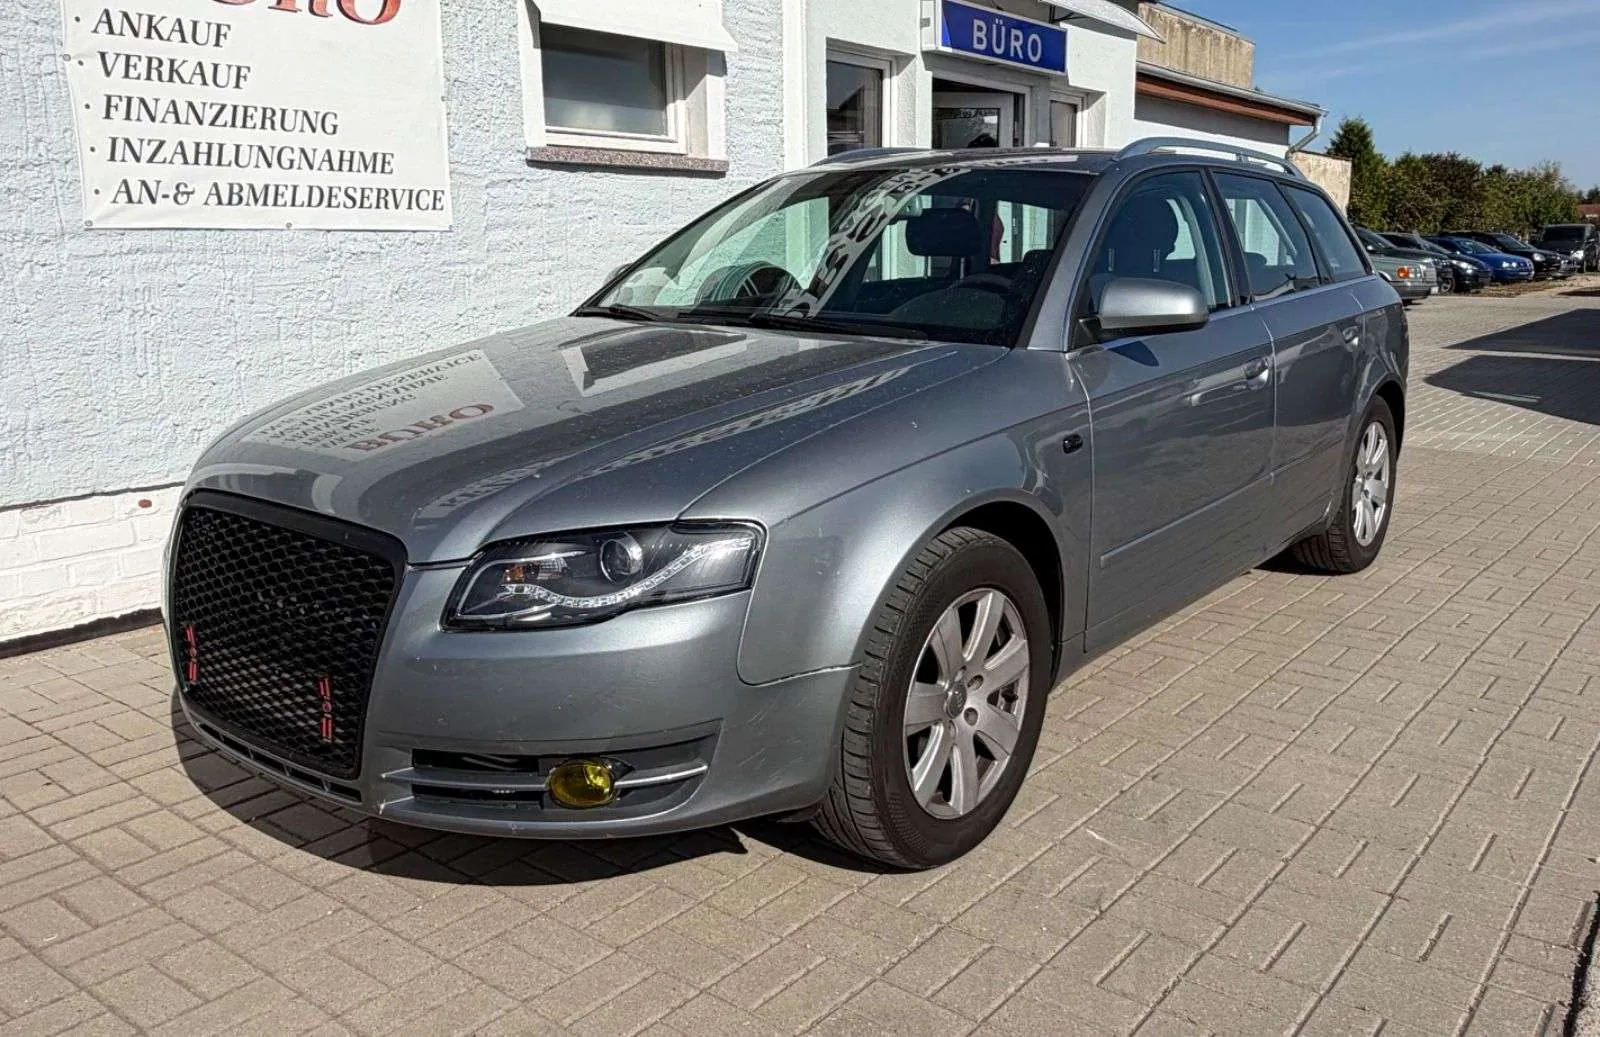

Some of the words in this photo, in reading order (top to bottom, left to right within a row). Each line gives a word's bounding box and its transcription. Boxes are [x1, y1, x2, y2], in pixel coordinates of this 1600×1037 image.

[91, 8, 231, 48] ANKAUF
[972, 18, 1043, 63] BÜRO
[97, 50, 251, 90] VERKAUF
[102, 94, 339, 136] FINANZIERUNG
[107, 136, 395, 175] INZAHLUNGNAHME
[203, 181, 445, 211] ABMELDESERVICE
